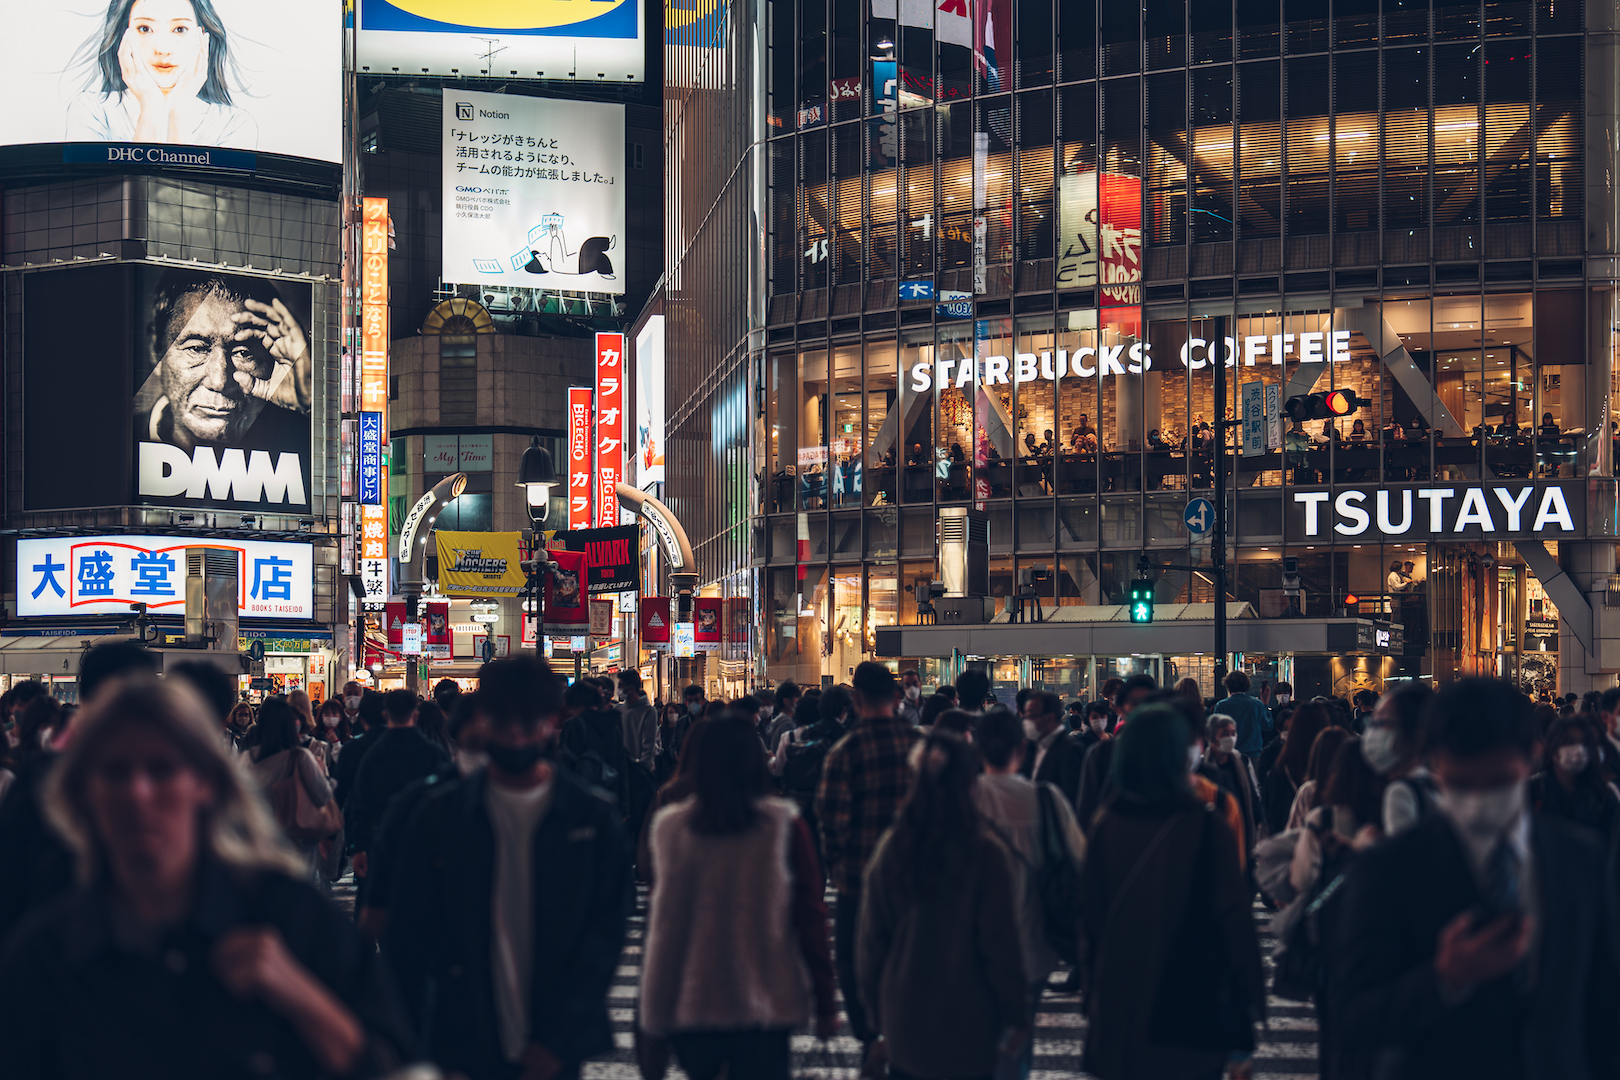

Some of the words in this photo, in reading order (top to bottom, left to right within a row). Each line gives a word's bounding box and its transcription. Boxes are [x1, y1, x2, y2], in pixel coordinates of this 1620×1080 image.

[479, 109, 510, 120] Notion
[107, 147, 144, 162] DHC
[146, 148, 211, 165] Channel
[451, 129, 558, 149] 「ナレッジがきちんと
[456, 146, 575, 166] 活用されるようになり、
[455, 185, 510, 195] GMOペパボ
[456, 162, 615, 185] チームの能力が拡張しました。」
[366, 204, 384, 339] クスリのことなら
[910, 342, 1153, 393] STARBUCKS
[1180, 330, 1351, 369] COFFEE
[598, 348, 620, 454] カラオケ
[1251, 387, 1261, 449] 渋谷駅前
[1268, 387, 1277, 446] スクランブル式
[138, 440, 307, 505] DMM
[363, 416, 377, 500] 大盛堂商事ビル
[433, 451, 457, 466] My
[461, 451, 487, 461] Time
[1293, 485, 1575, 536] TSUTAYA
[585, 538, 630, 568] ALVARK
[31, 550, 294, 601] 大盛堂店
[367, 560, 383, 596] 牛繁
[251, 604, 273, 613] BOOKS
[274, 605, 303, 613] TAISEIDO
